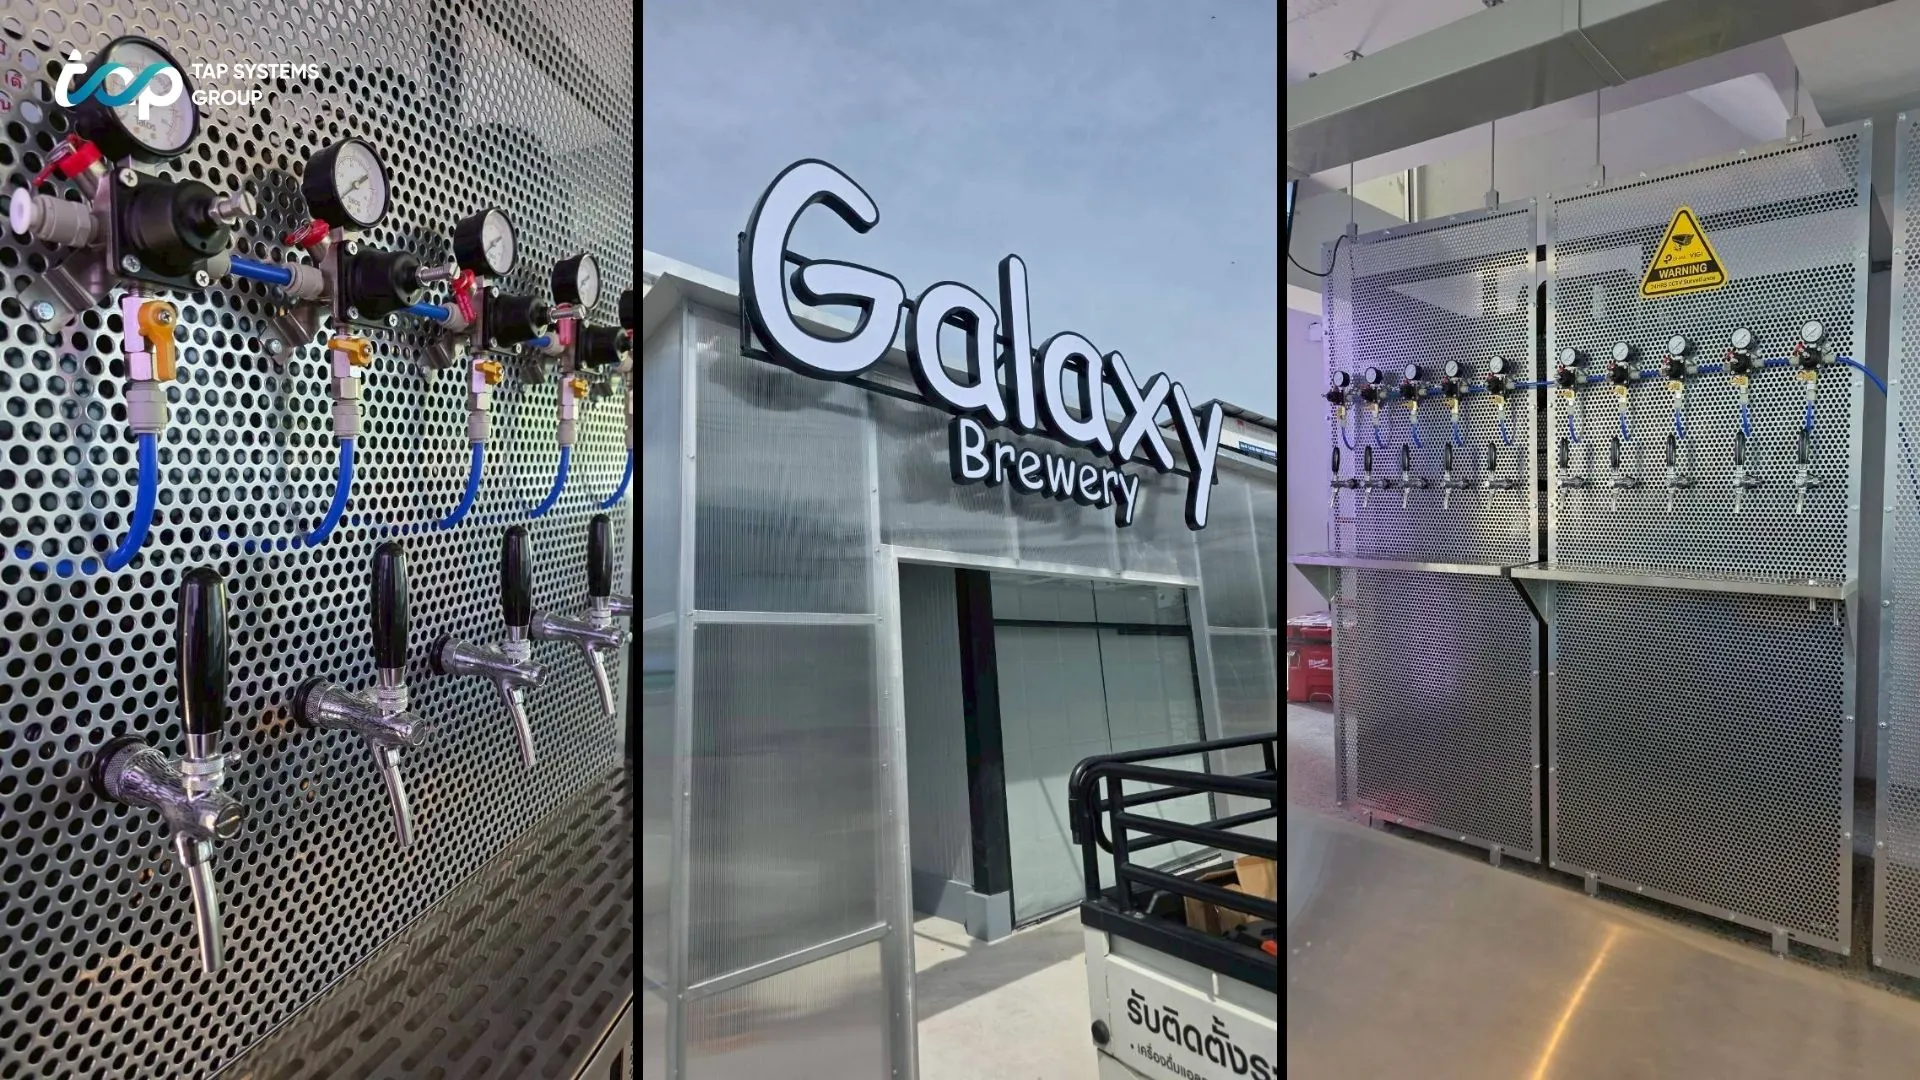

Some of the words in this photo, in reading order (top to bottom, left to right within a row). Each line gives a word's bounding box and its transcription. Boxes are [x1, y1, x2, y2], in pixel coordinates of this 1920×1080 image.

[1658, 262, 1708, 280] WARNING
[745, 158, 1223, 530] Galaxy
[951, 417, 1139, 527] Brewery
[1127, 988, 1277, 1080] รับติดตั้งร
